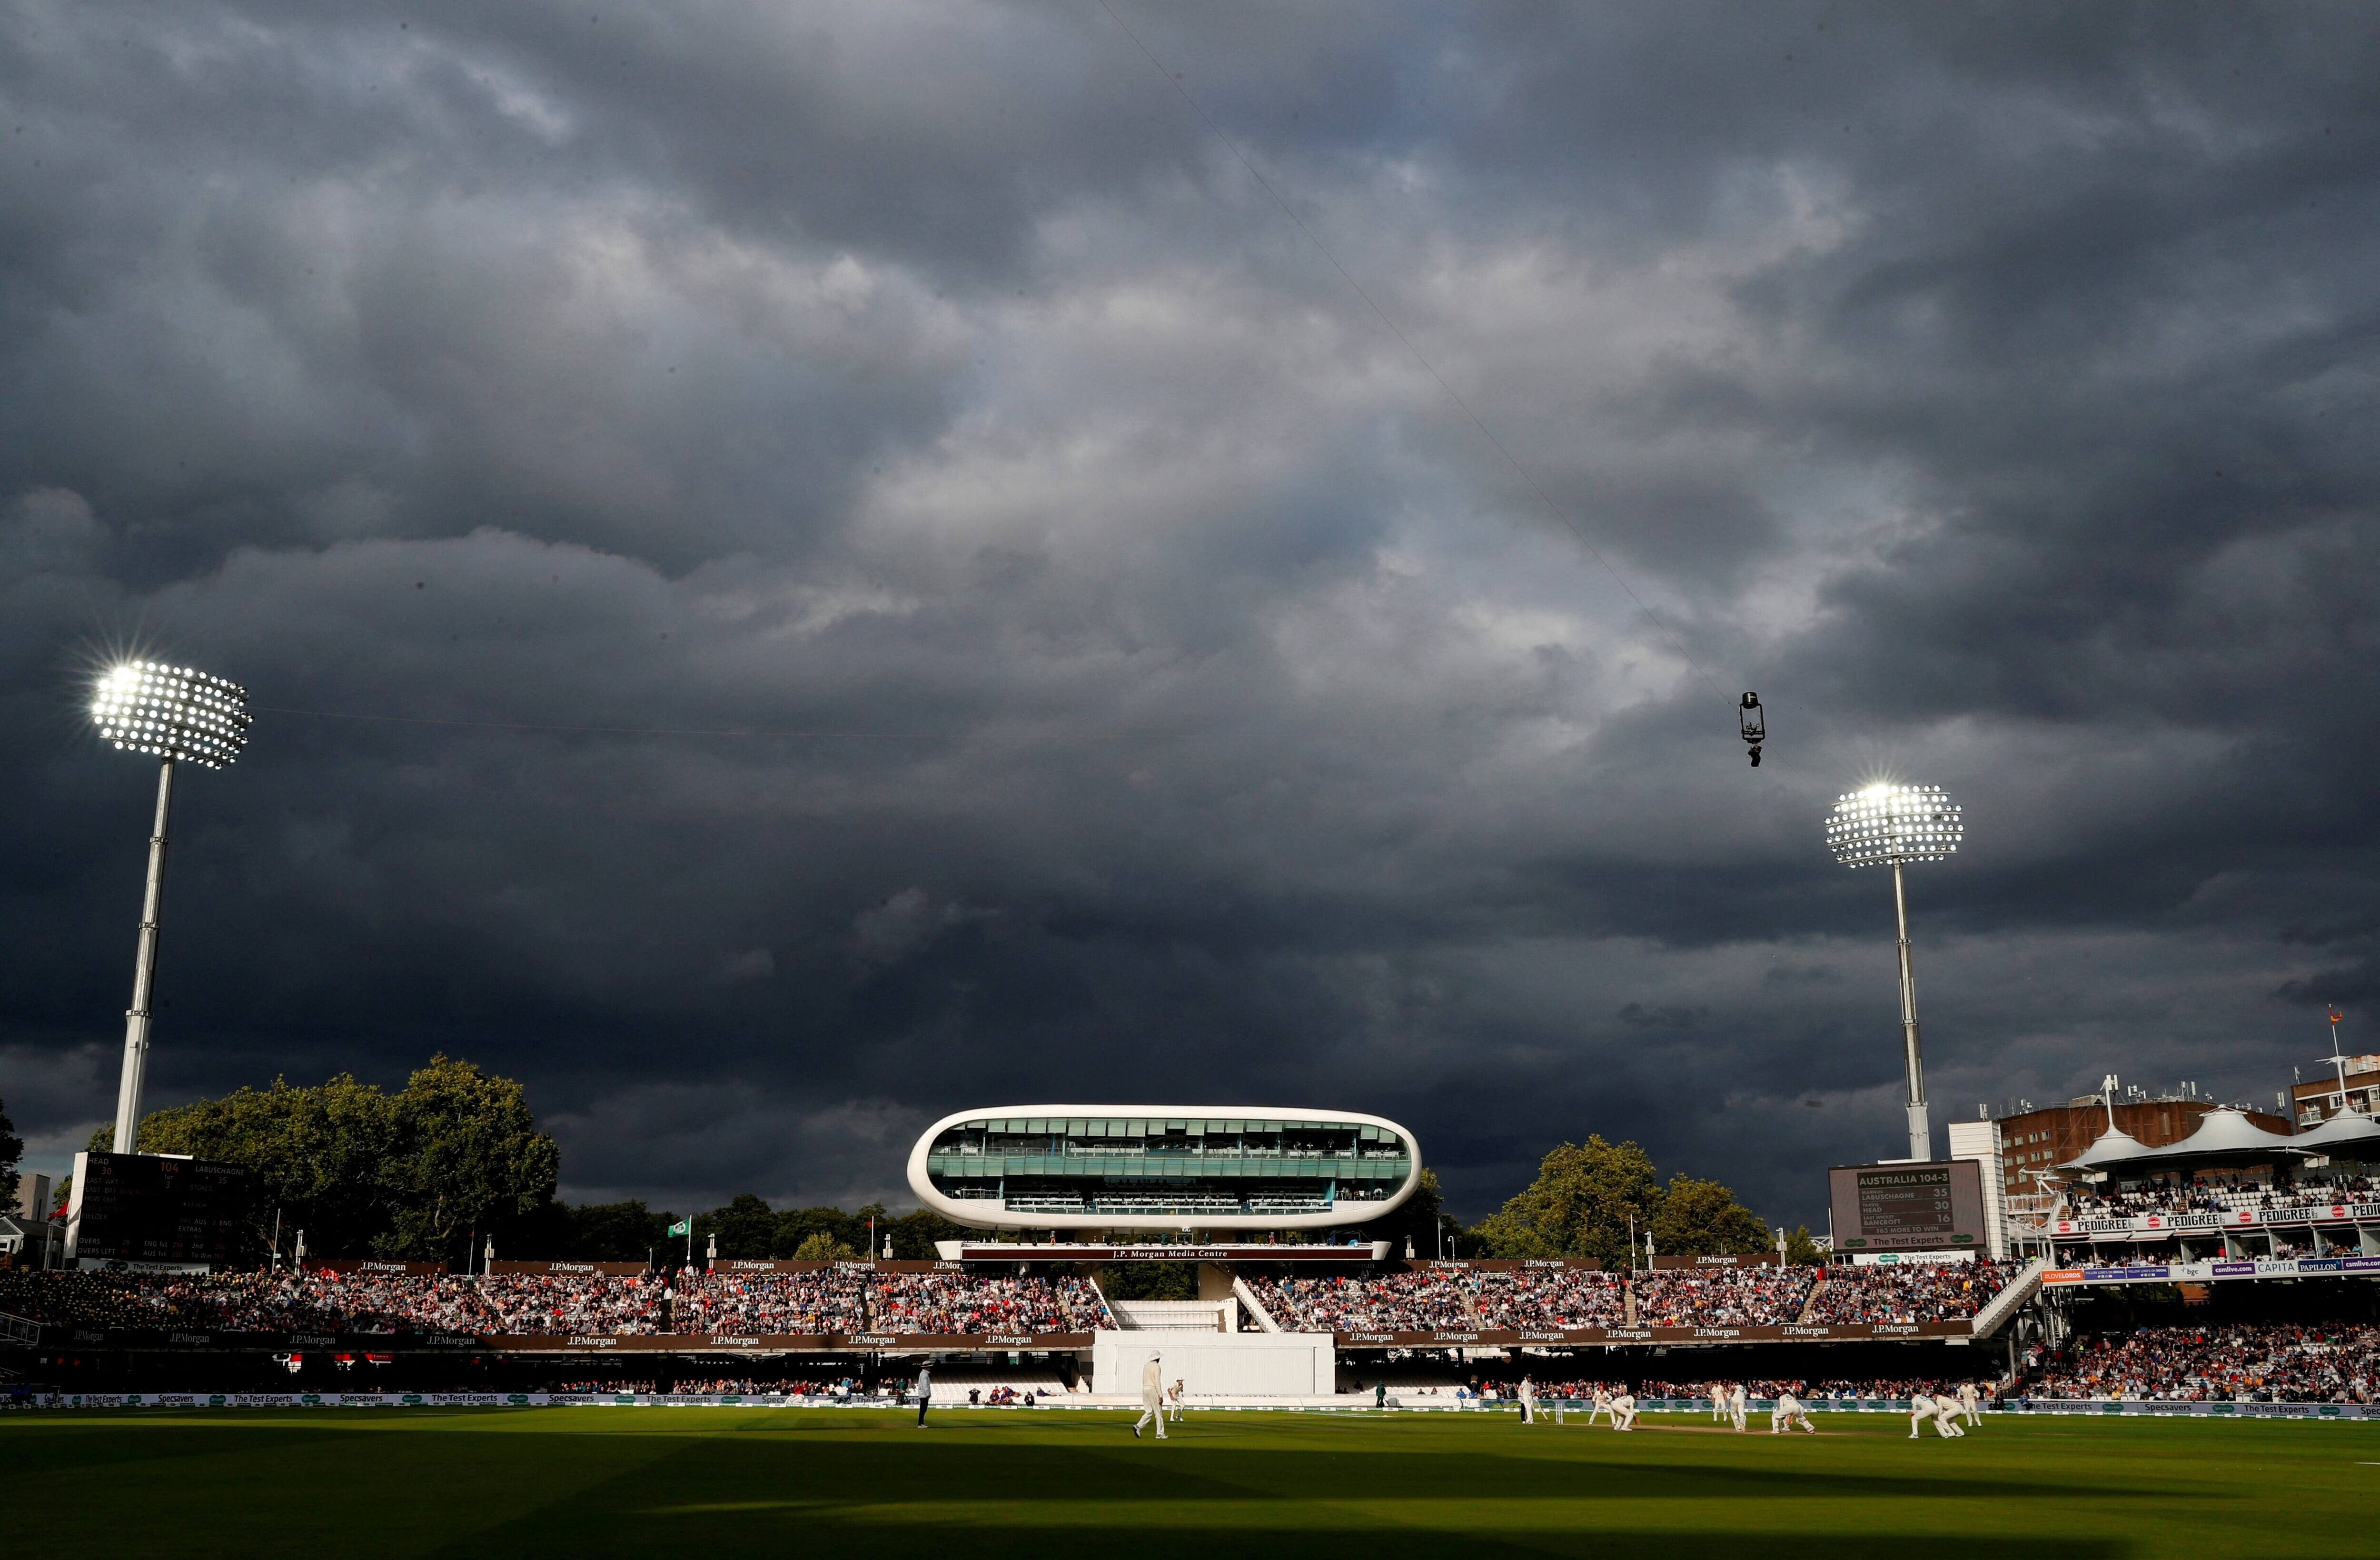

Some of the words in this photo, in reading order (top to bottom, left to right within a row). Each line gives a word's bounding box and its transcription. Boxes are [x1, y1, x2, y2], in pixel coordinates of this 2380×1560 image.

[101, 1167, 111, 1175] 30
[160, 1162, 179, 1172] 104
[195, 1166, 244, 1176] LABUSCHAGNE
[217, 1176, 227, 1184] 35
[1859, 1175, 1917, 1185] AUSTRALIA
[1920, 1173, 1948, 1182] 104-3
[1862, 1192, 1914, 1201] LABUSCHAGNE
[1934, 1202, 1949, 1210] 30
[1937, 1214, 1950, 1222] 16
[2167, 1213, 2218, 1227] PEDIGREE
[2259, 1208, 2311, 1222] PEDIGREE
[2078, 1220, 2128, 1231] PEDIGREE
[1911, 1237, 1944, 1245] Experts
[1696, 1256, 1737, 1265] J.P.Morgan
[360, 1262, 406, 1273] J.P.Morgan
[549, 1263, 594, 1273] J.P.Morgan
[731, 1262, 775, 1272] J.P.Morgan
[2258, 1262, 2295, 1272] CAPITA
[1694, 1328, 1740, 1338] J.P.Morgan
[1782, 1327, 1829, 1337] J.P.Morgan
[1872, 1324, 1919, 1335] J.P.Morgan
[73, 1330, 103, 1344] J.P.Morgan
[170, 1333, 209, 1345] J.P.Morgan
[1350, 1333, 1393, 1343] J.P.Morgan
[1434, 1332, 1478, 1342] J.P.Morgan
[1519, 1331, 1564, 1341] J.P.Morgan
[1606, 1330, 1652, 1340] J.P.Morgan
[290, 1335, 336, 1347] J.P.Morgan
[427, 1336, 475, 1347] J.P.Morgan
[567, 1337, 616, 1347] J.P.Morgan
[711, 1336, 759, 1347] J.P.Morgan
[848, 1336, 895, 1346] J.P.Morgan
[985, 1335, 1032, 1346] J.P.Morgan
[103, 1395, 122, 1405] Experts
[159, 1394, 193, 1403] Specsavers
[266, 1395, 293, 1403] Experts
[340, 1394, 383, 1402] Specsavers
[467, 1395, 497, 1403] Experts
[681, 1396, 711, 1404] Experts
[2061, 1403, 2092, 1411] Experts
[2145, 1404, 2192, 1412] Specsavers
[2279, 1406, 2310, 1414] Experts
